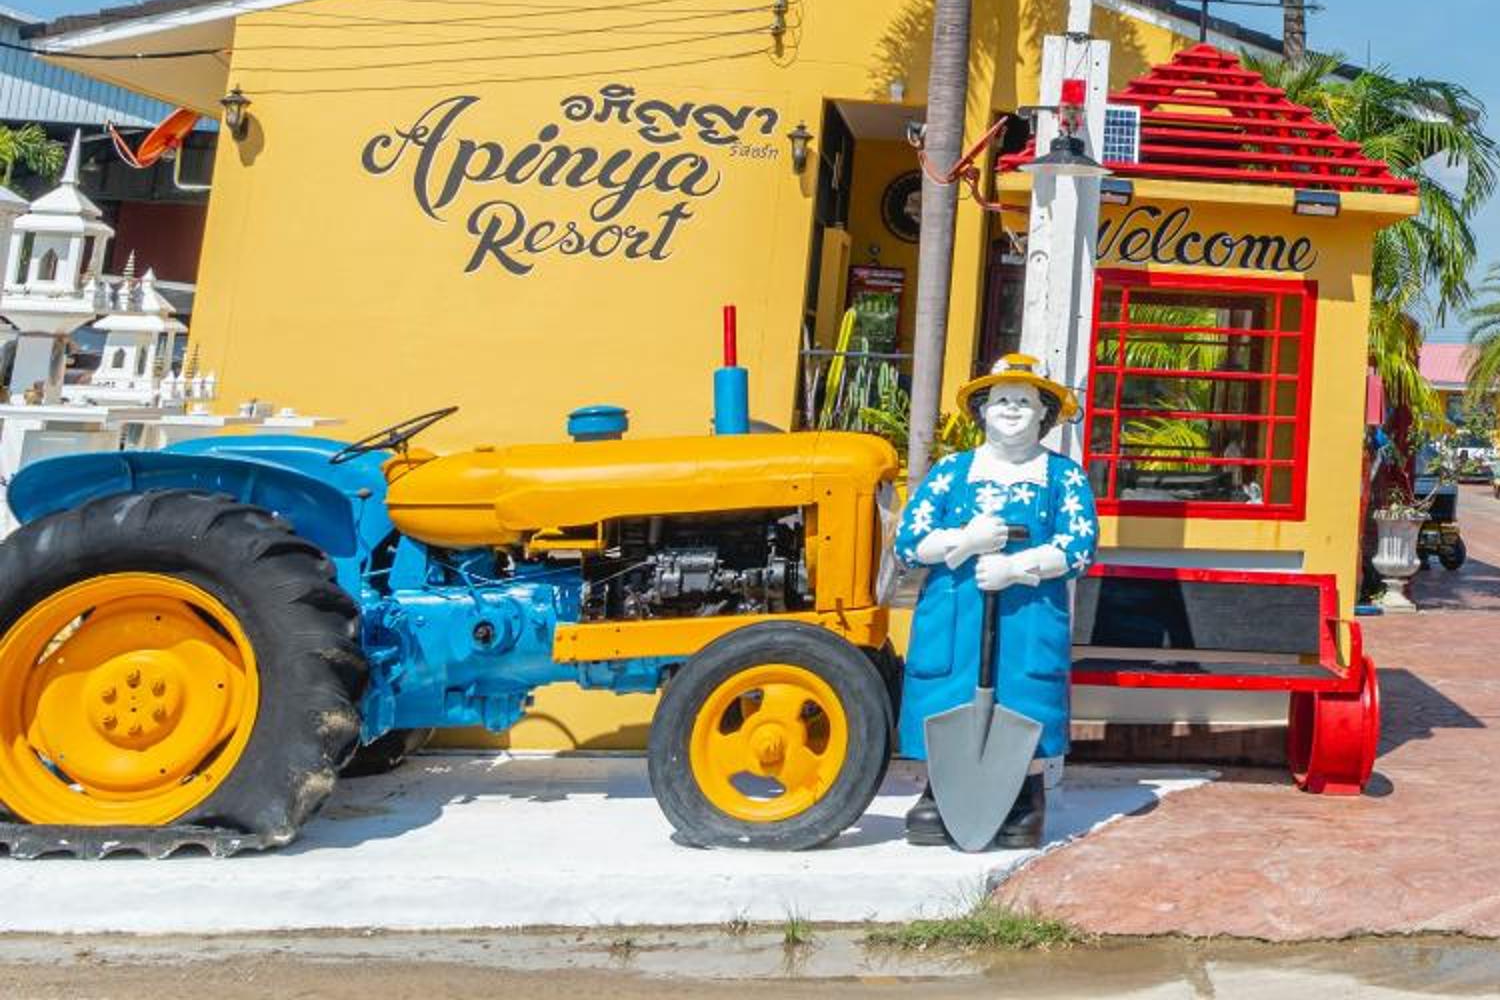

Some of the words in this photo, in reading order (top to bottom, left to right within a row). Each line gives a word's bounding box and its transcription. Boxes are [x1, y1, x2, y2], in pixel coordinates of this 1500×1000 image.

[560, 84, 779, 145] อภิญญา
[361, 95, 721, 223] Apinya
[464, 201, 697, 275] Resort
